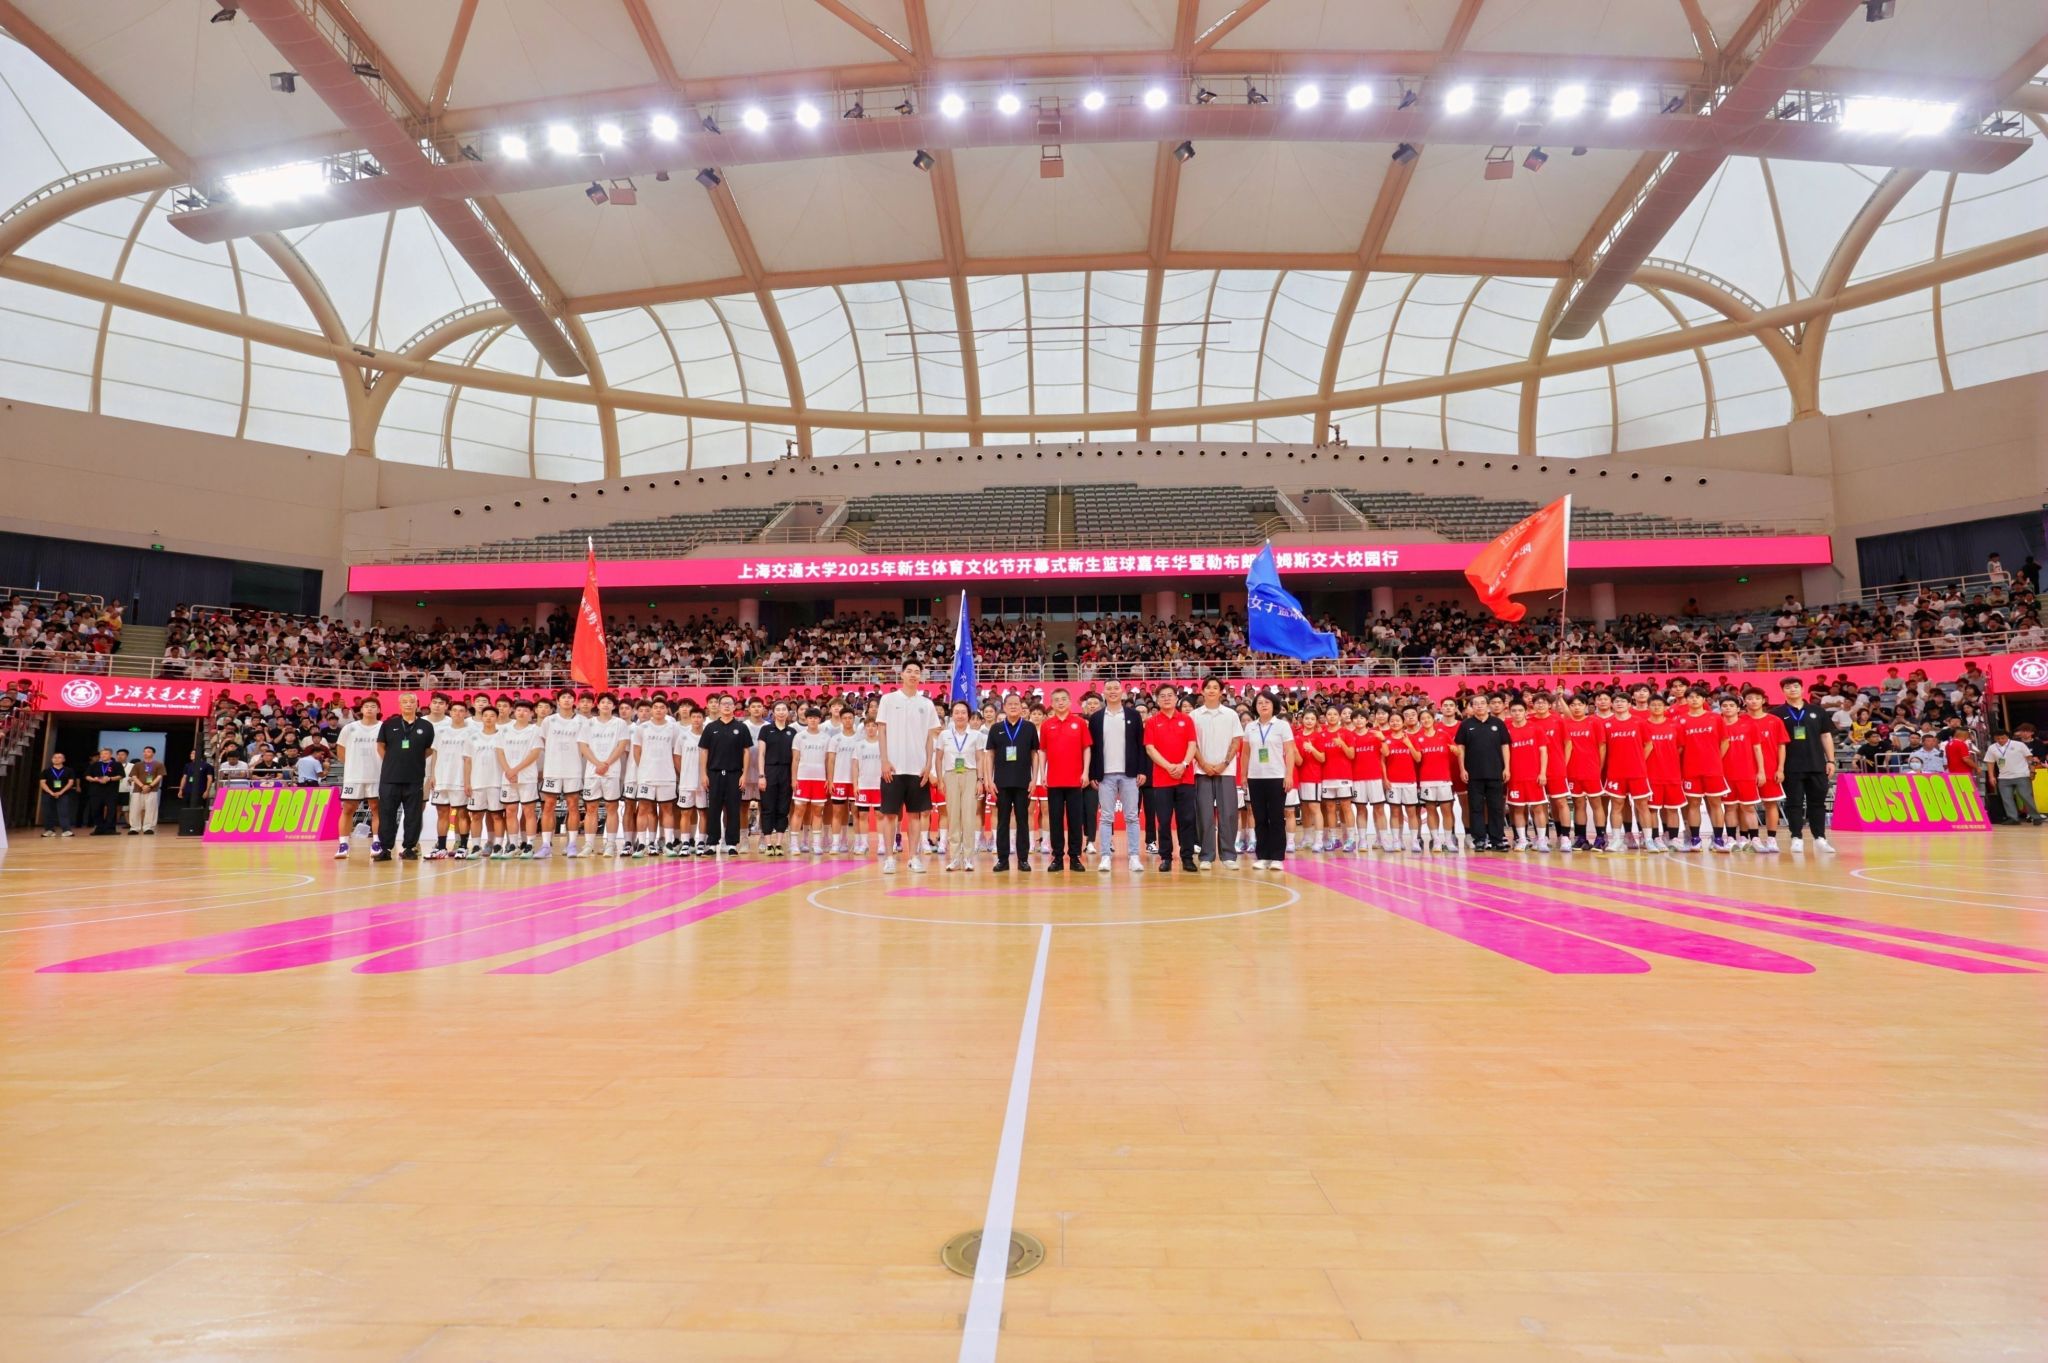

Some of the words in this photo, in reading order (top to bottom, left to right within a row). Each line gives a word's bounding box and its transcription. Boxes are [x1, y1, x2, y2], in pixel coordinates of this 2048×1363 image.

[737, 550, 1399, 579] 上海交通大学2025年新生体育文化节开幕式新生篮球嘉年华暨勒布朗姆斯交大校园行
[106, 684, 203, 704] 上海交通大学
[209, 788, 276, 833] JUST
[268, 788, 308, 833] DO
[301, 788, 332, 833] IT
[1854, 774, 1920, 823] JUST
[1912, 774, 1959, 823] DO
[1949, 774, 1984, 823] IT
